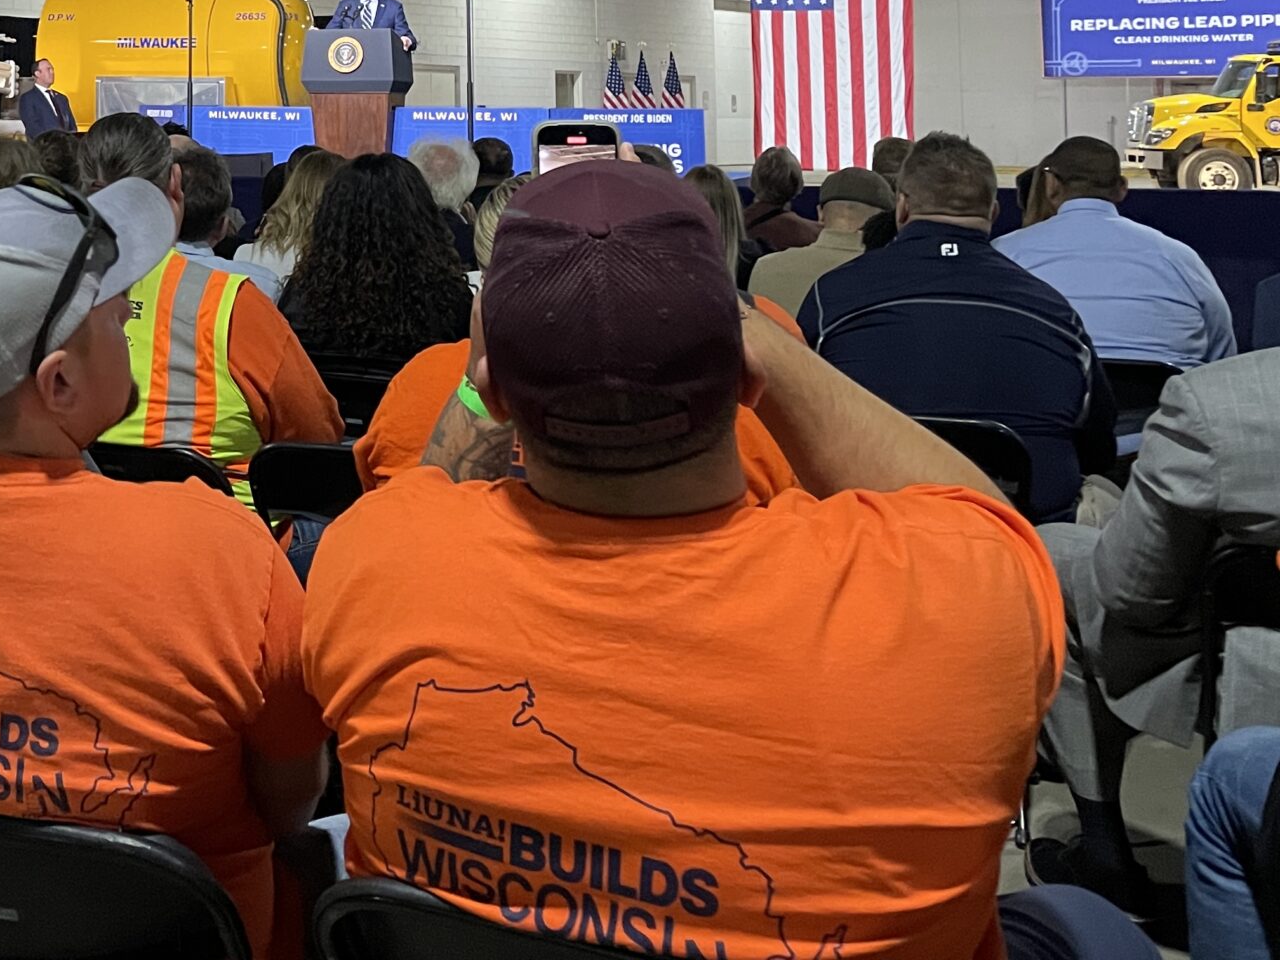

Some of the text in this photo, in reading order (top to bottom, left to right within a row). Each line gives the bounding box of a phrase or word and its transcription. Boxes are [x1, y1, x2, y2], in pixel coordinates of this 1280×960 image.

[235, 13, 267, 21] 26635
[1070, 17, 1180, 31] REPLACING
[1183, 15, 1237, 28] LEAD
[1113, 33, 1255, 44] CLEAN DRINKING WATER
[208, 111, 281, 120] MILWAUKEE,
[412, 111, 518, 122] MILWAUEE, WI
[630, 114, 644, 123] JOE
[647, 114, 672, 123] BIDEN
[396, 784, 719, 917] LiUNA! BUILDS
